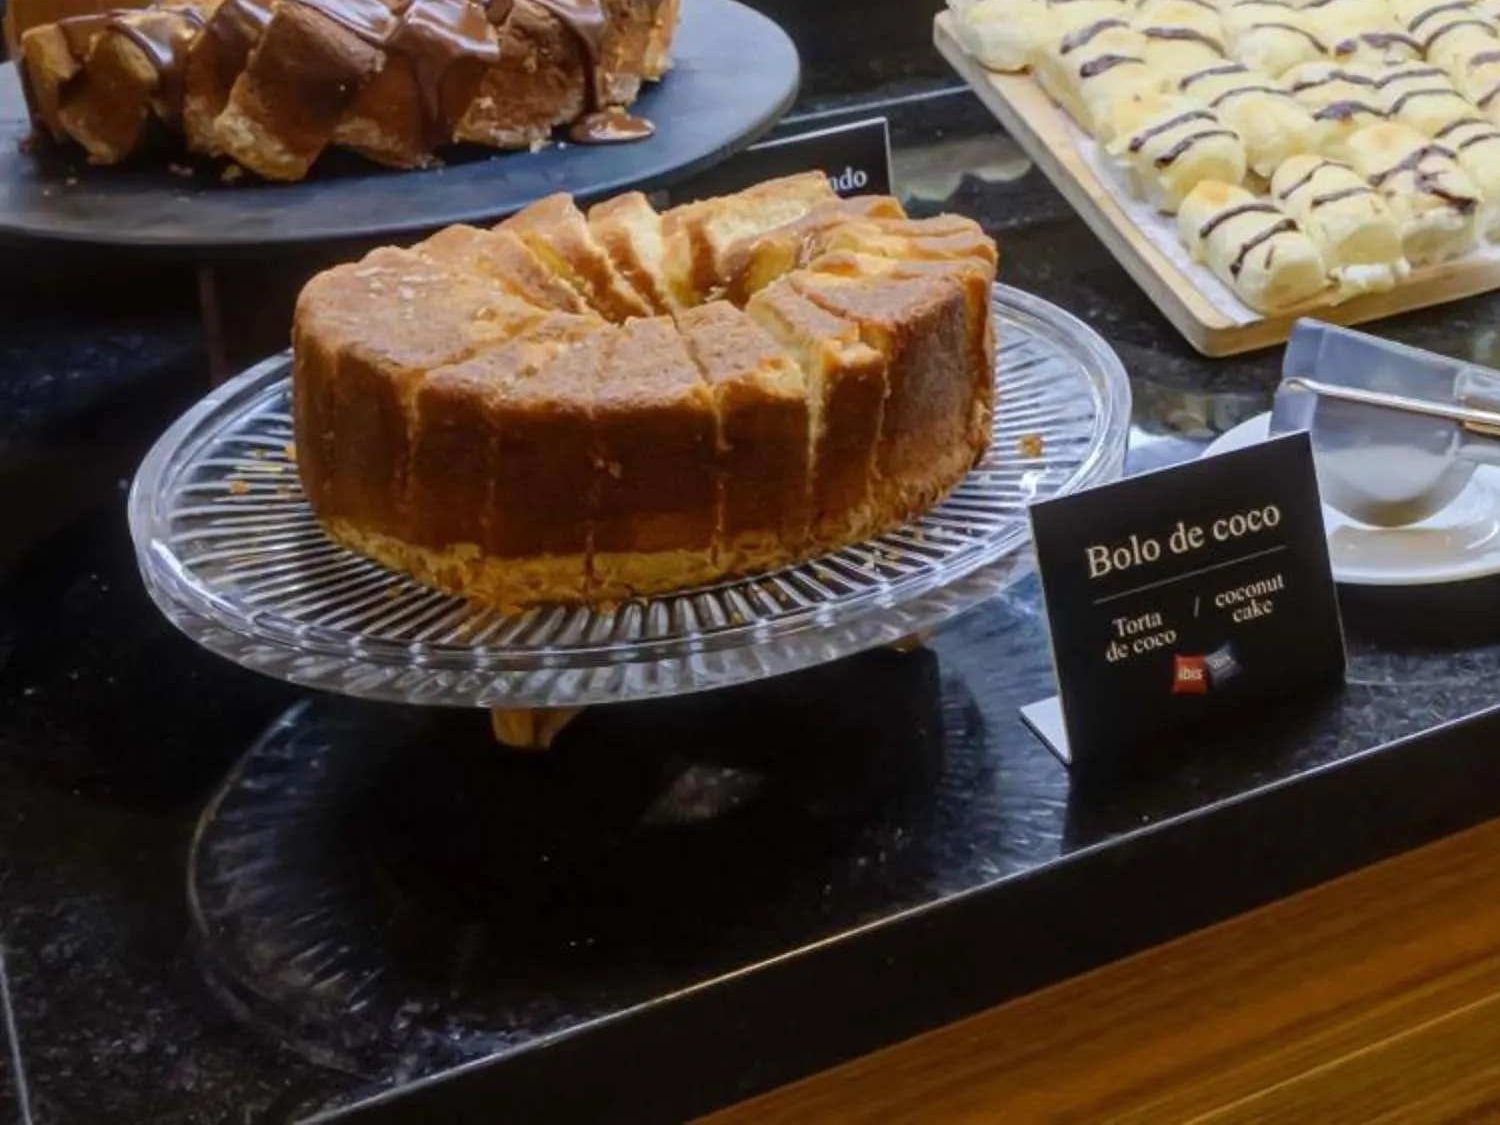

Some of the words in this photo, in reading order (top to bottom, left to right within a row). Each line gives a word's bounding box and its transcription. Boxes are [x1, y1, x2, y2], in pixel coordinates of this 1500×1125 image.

[1085, 534, 1161, 580] Bolo
[1169, 522, 1205, 555] de
[1213, 504, 1281, 542] coco
[1112, 609, 1164, 638] Torta
[1215, 574, 1285, 607] coconut
[1232, 597, 1274, 624] cake
[1105, 637, 1129, 663] de
[1133, 628, 1178, 656] coco
